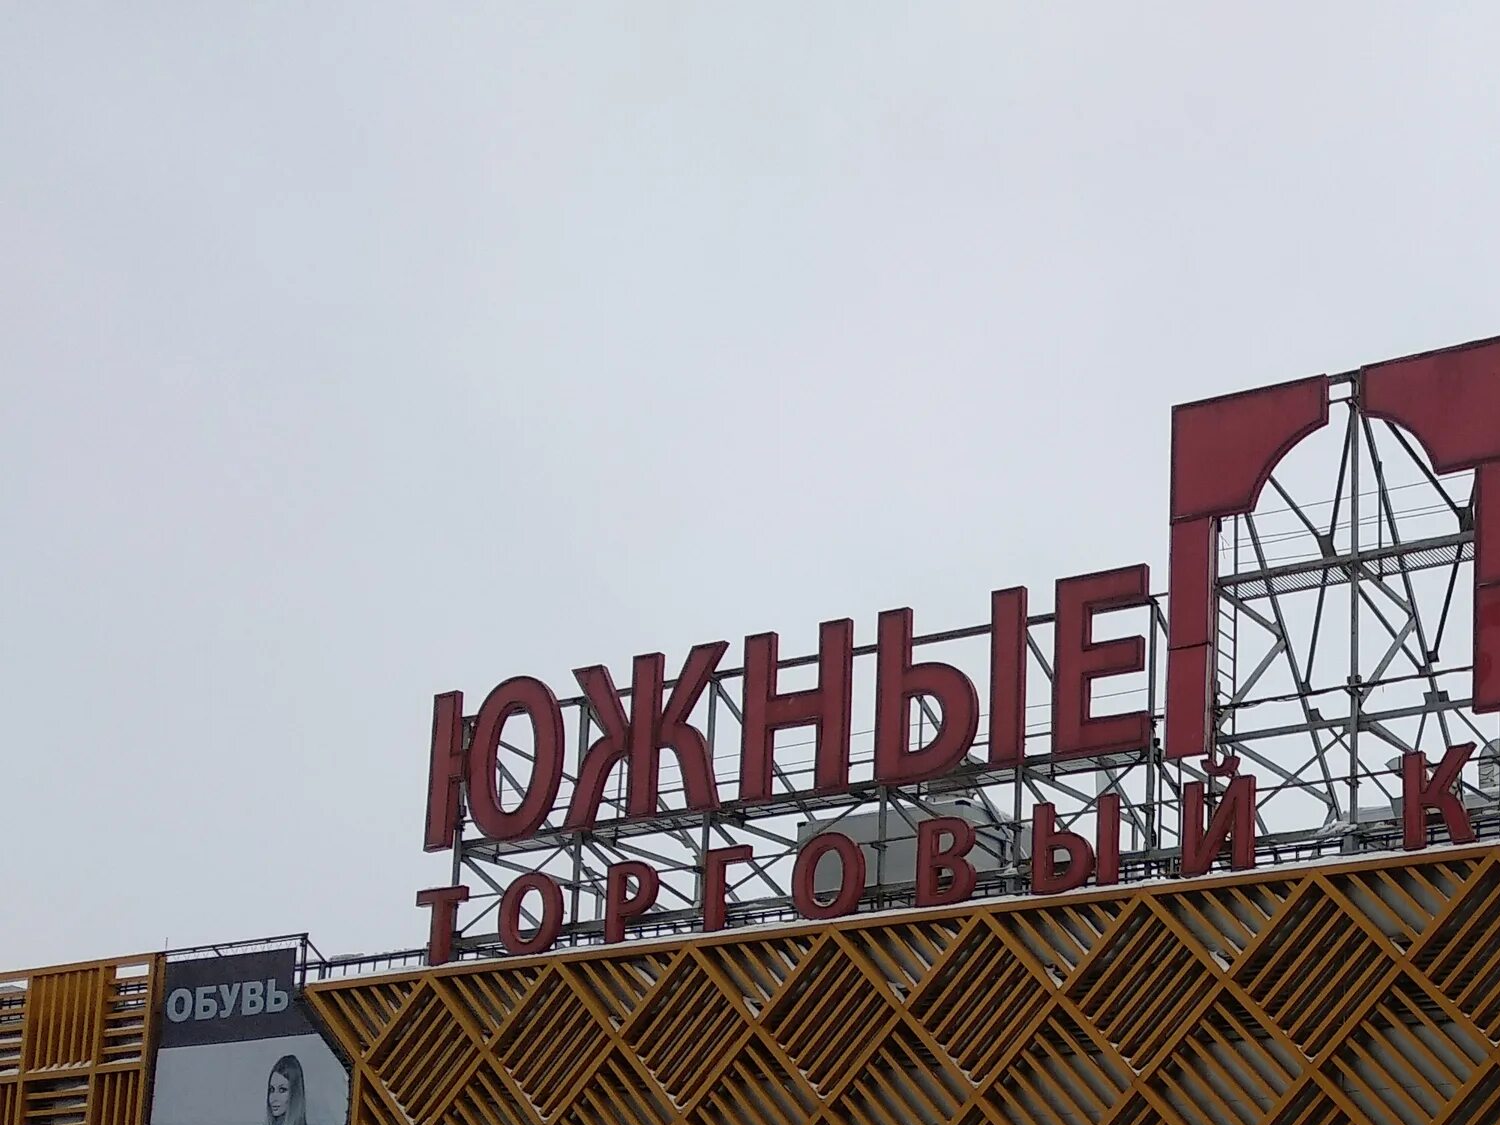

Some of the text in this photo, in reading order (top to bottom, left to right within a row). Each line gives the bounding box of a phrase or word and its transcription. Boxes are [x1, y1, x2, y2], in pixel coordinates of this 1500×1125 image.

[423, 563, 1150, 852] ЮЖНЫЕ
[416, 755, 1257, 966] ТОРГОВЫЙ
[166, 979, 288, 1023] ОБУВЬ
